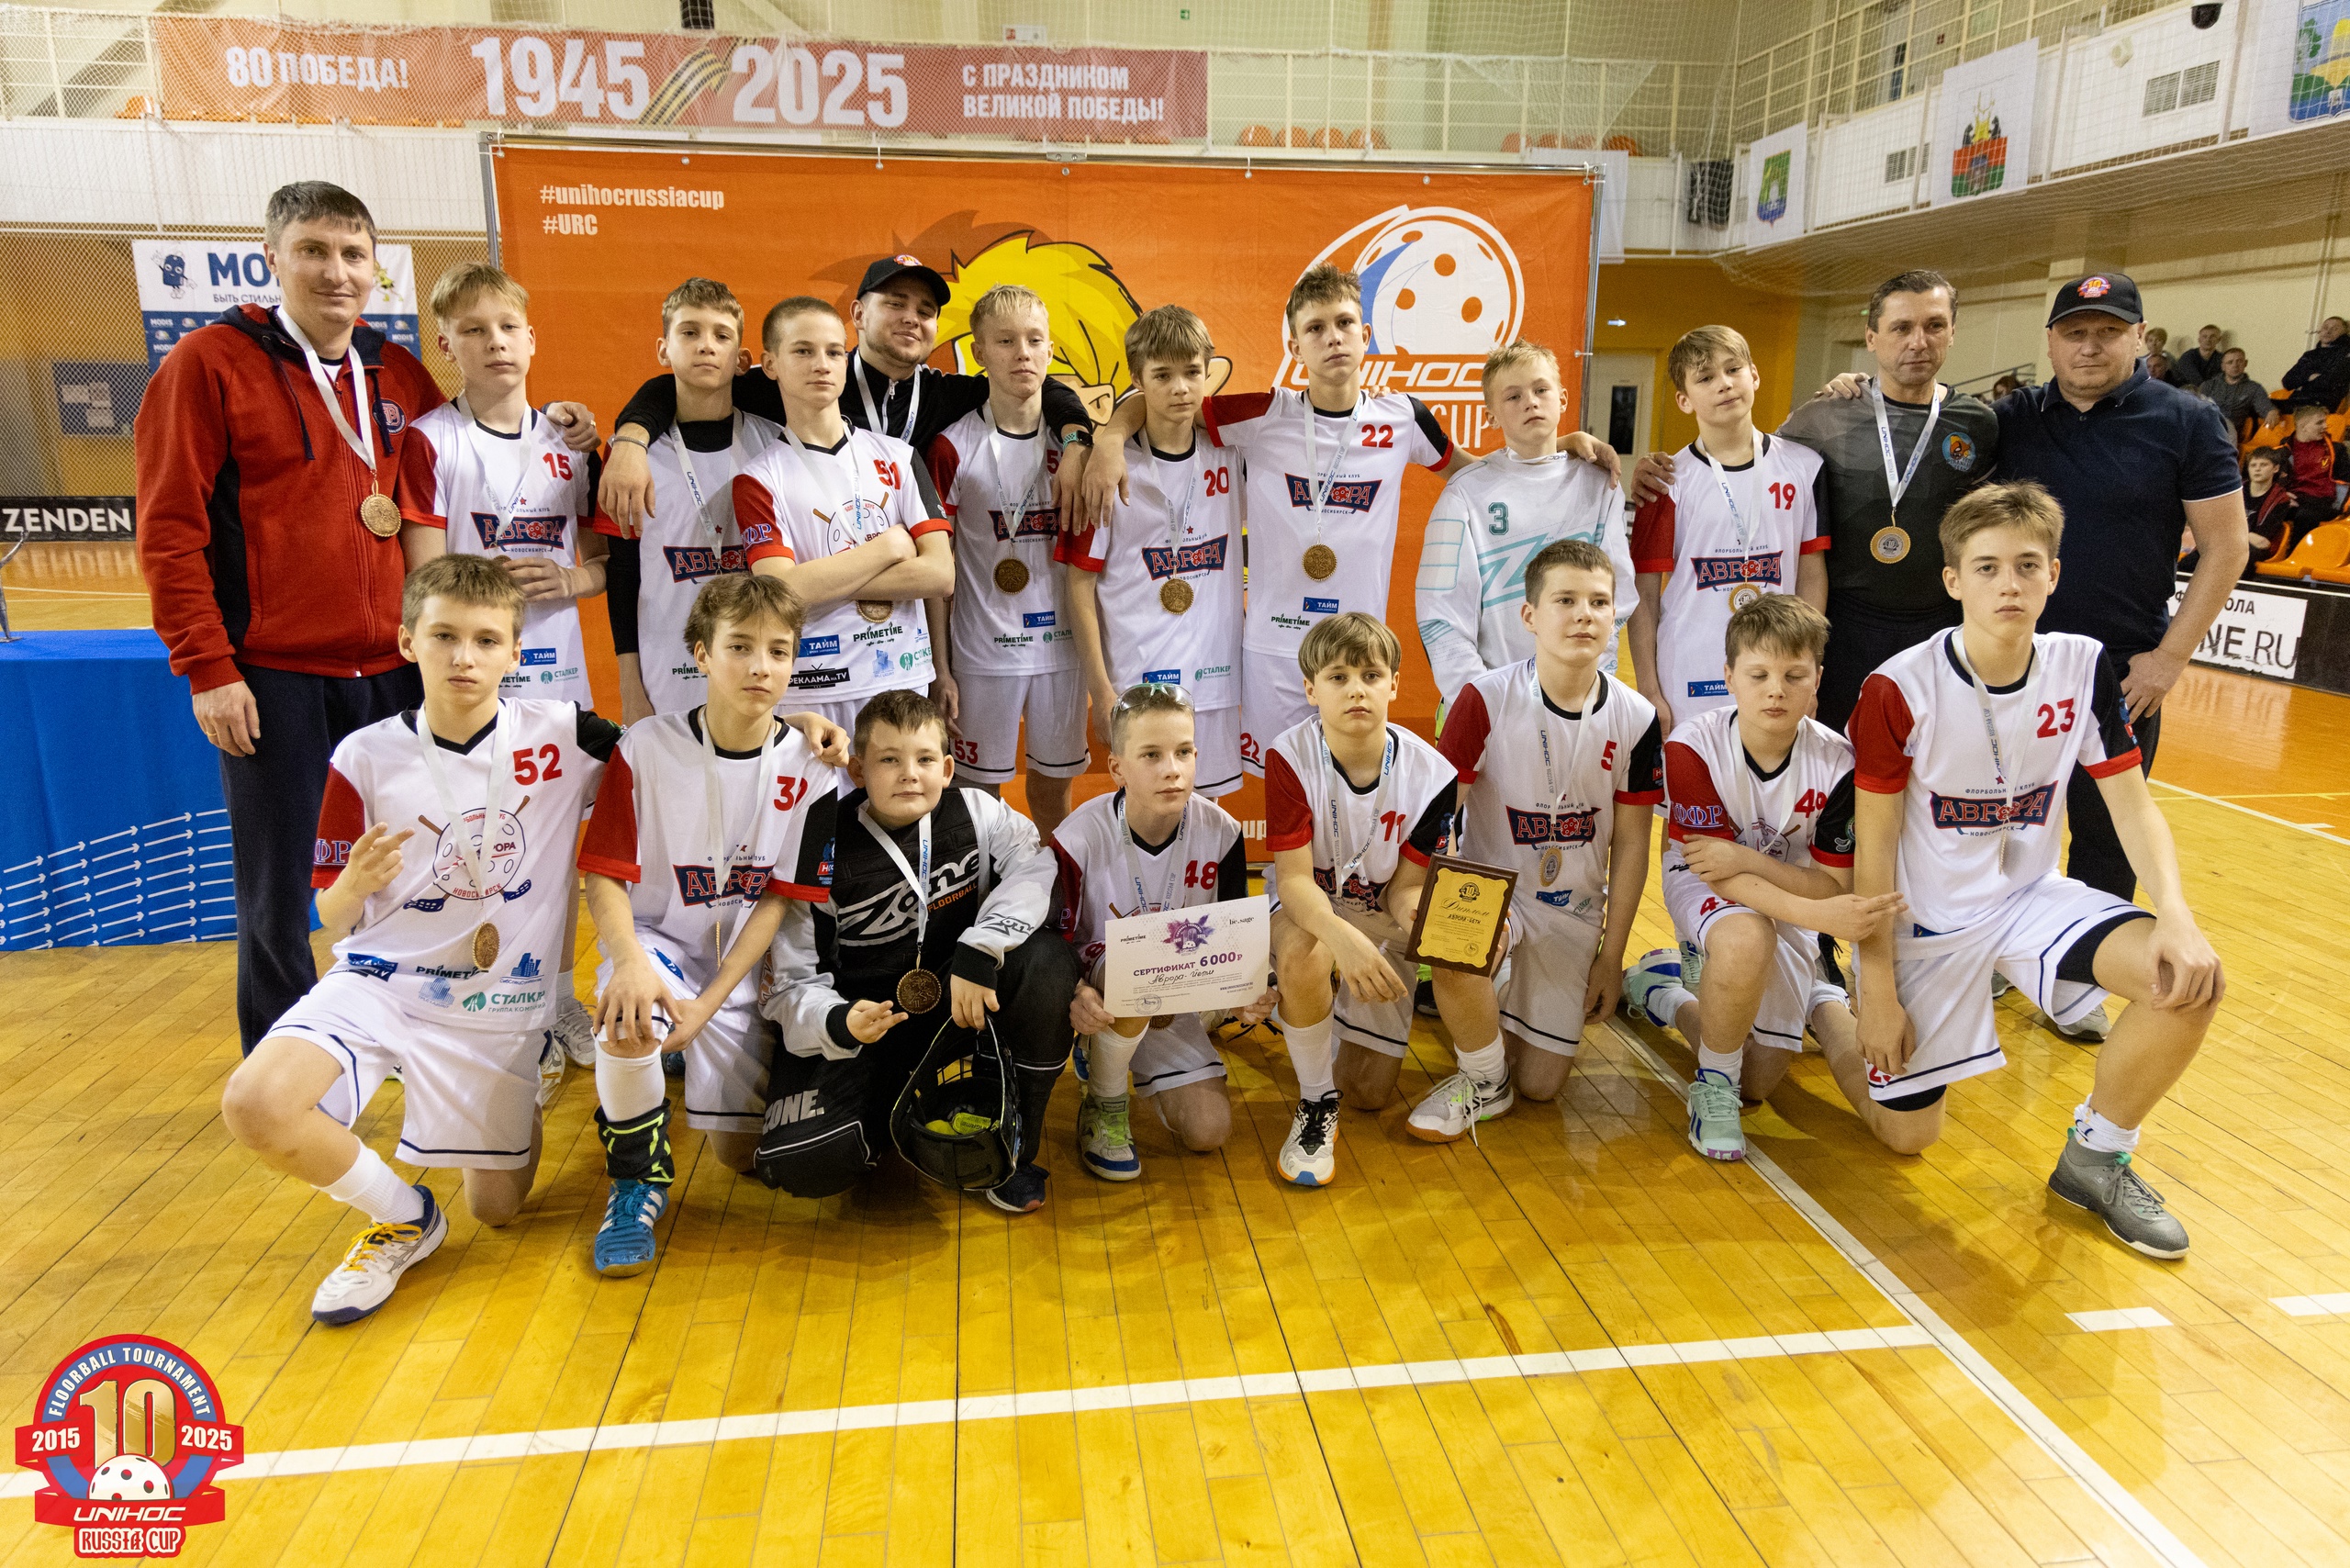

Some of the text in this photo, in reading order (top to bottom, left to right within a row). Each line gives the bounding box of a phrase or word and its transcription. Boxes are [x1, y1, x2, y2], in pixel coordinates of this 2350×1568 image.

[226, 47, 408, 91] 80 ПОБЕДА!
[472, 36, 908, 129] 1945 2025
[963, 63, 1128, 91] С ПРАЗДНИКОМ
[963, 92, 1164, 124] ВЕЛИКОЙ ПОБЕДЫ!
[540, 184, 725, 210] #unihocrussiacup
[543, 214, 599, 235] #URC
[213, 293, 281, 304] БЫТЬ СТИЛЬН
[1361, 424, 1393, 448] 22
[1881, 427, 1892, 457] UNIHOC
[543, 453, 573, 481] 15
[873, 459, 901, 490] 51
[1046, 449, 1064, 475] 5
[1904, 454, 1919, 483] UNIHOC
[687, 471, 704, 507] UNIHOC
[1203, 466, 1229, 497] 20
[1319, 469, 1335, 502] UNIHOC
[1768, 482, 1796, 510] 19
[1018, 485, 1035, 516] UNIHOC
[1721, 482, 1737, 512] UNIHOC
[2, 508, 132, 532] ZENDEN
[1488, 502, 1509, 535] 3
[1271, 613, 1310, 626] PRIMETIME
[1317, 600, 1337, 609] ТАЙМ
[809, 639, 837, 650] ТАЙМ
[854, 622, 902, 642] PRIMETIME
[994, 633, 1033, 643] PRIMETIME
[533, 651, 555, 659] ТАЙМ
[1158, 672, 1179, 680] ТАЙМ
[2037, 698, 2076, 738] 23
[955, 739, 979, 765] 53
[1540, 730, 1551, 766] UNIHOC
[1601, 740, 1617, 771] 5
[513, 744, 562, 786] 52
[1939, 792, 2047, 822] АВРОРА
[1380, 811, 1406, 844] 11
[1348, 837, 1372, 868] UNIHOC
[1184, 860, 1218, 890] 48
[927, 882, 978, 913] FLOORBALL
[1135, 877, 1147, 912] UNIHOC
[1134, 961, 1196, 977] СЕРТИФИКАТ
